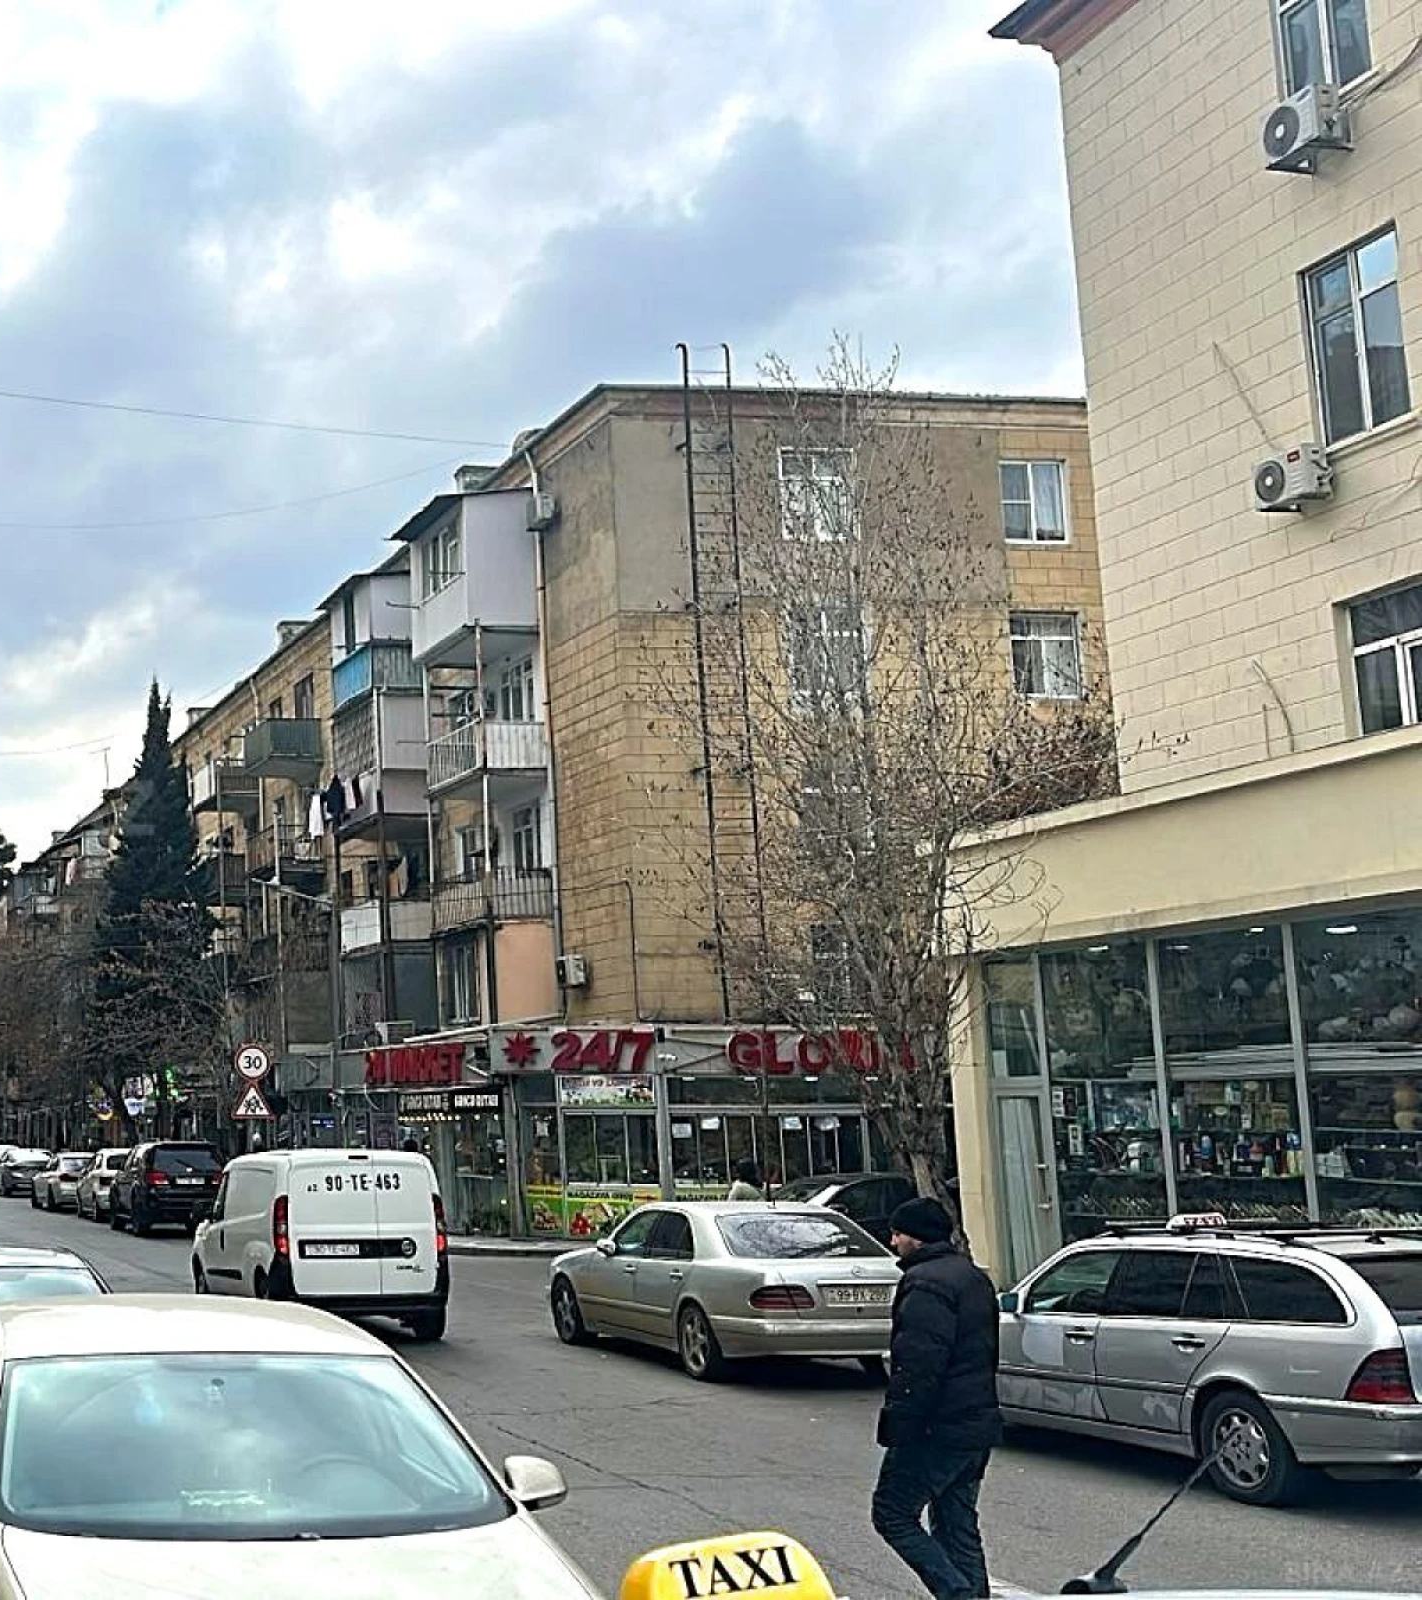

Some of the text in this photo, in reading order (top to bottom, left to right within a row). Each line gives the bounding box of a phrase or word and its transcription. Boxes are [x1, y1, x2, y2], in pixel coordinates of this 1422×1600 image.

[551, 1030, 656, 1072] 24/7
[243, 1055, 262, 1069] 30
[325, 1173, 400, 1191] 90-TE-463
[1184, 1216, 1223, 1226] TAXI
[668, 1546, 800, 1599] TAXI
